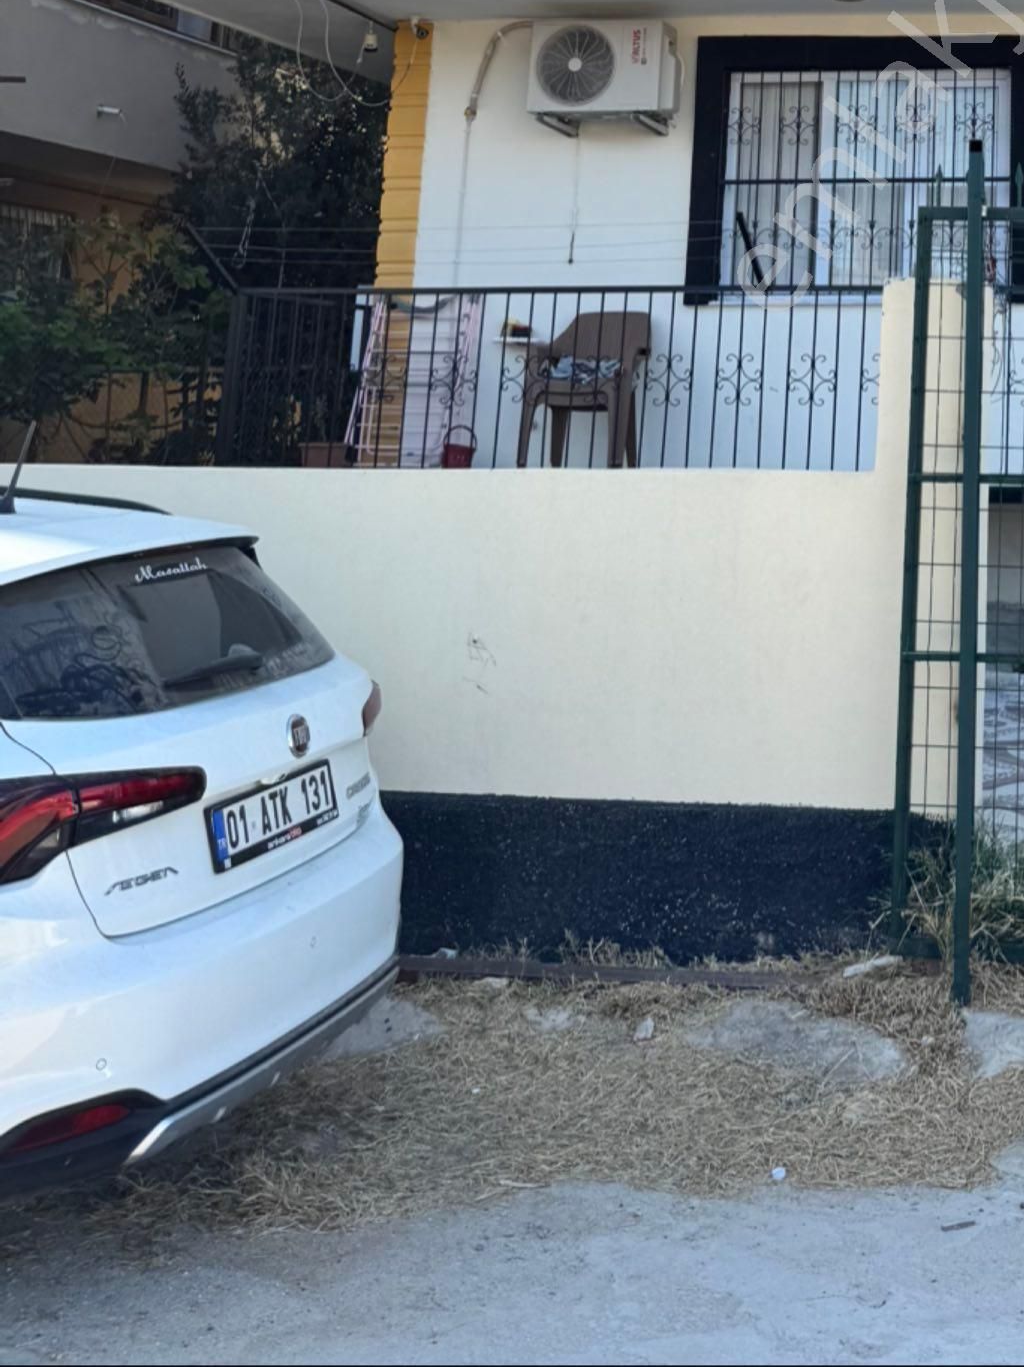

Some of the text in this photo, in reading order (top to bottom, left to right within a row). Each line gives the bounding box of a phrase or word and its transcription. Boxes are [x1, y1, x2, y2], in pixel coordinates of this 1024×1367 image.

[226, 804, 249, 849] 01
[261, 786, 292, 835] ATK
[301, 770, 329, 815] 131
